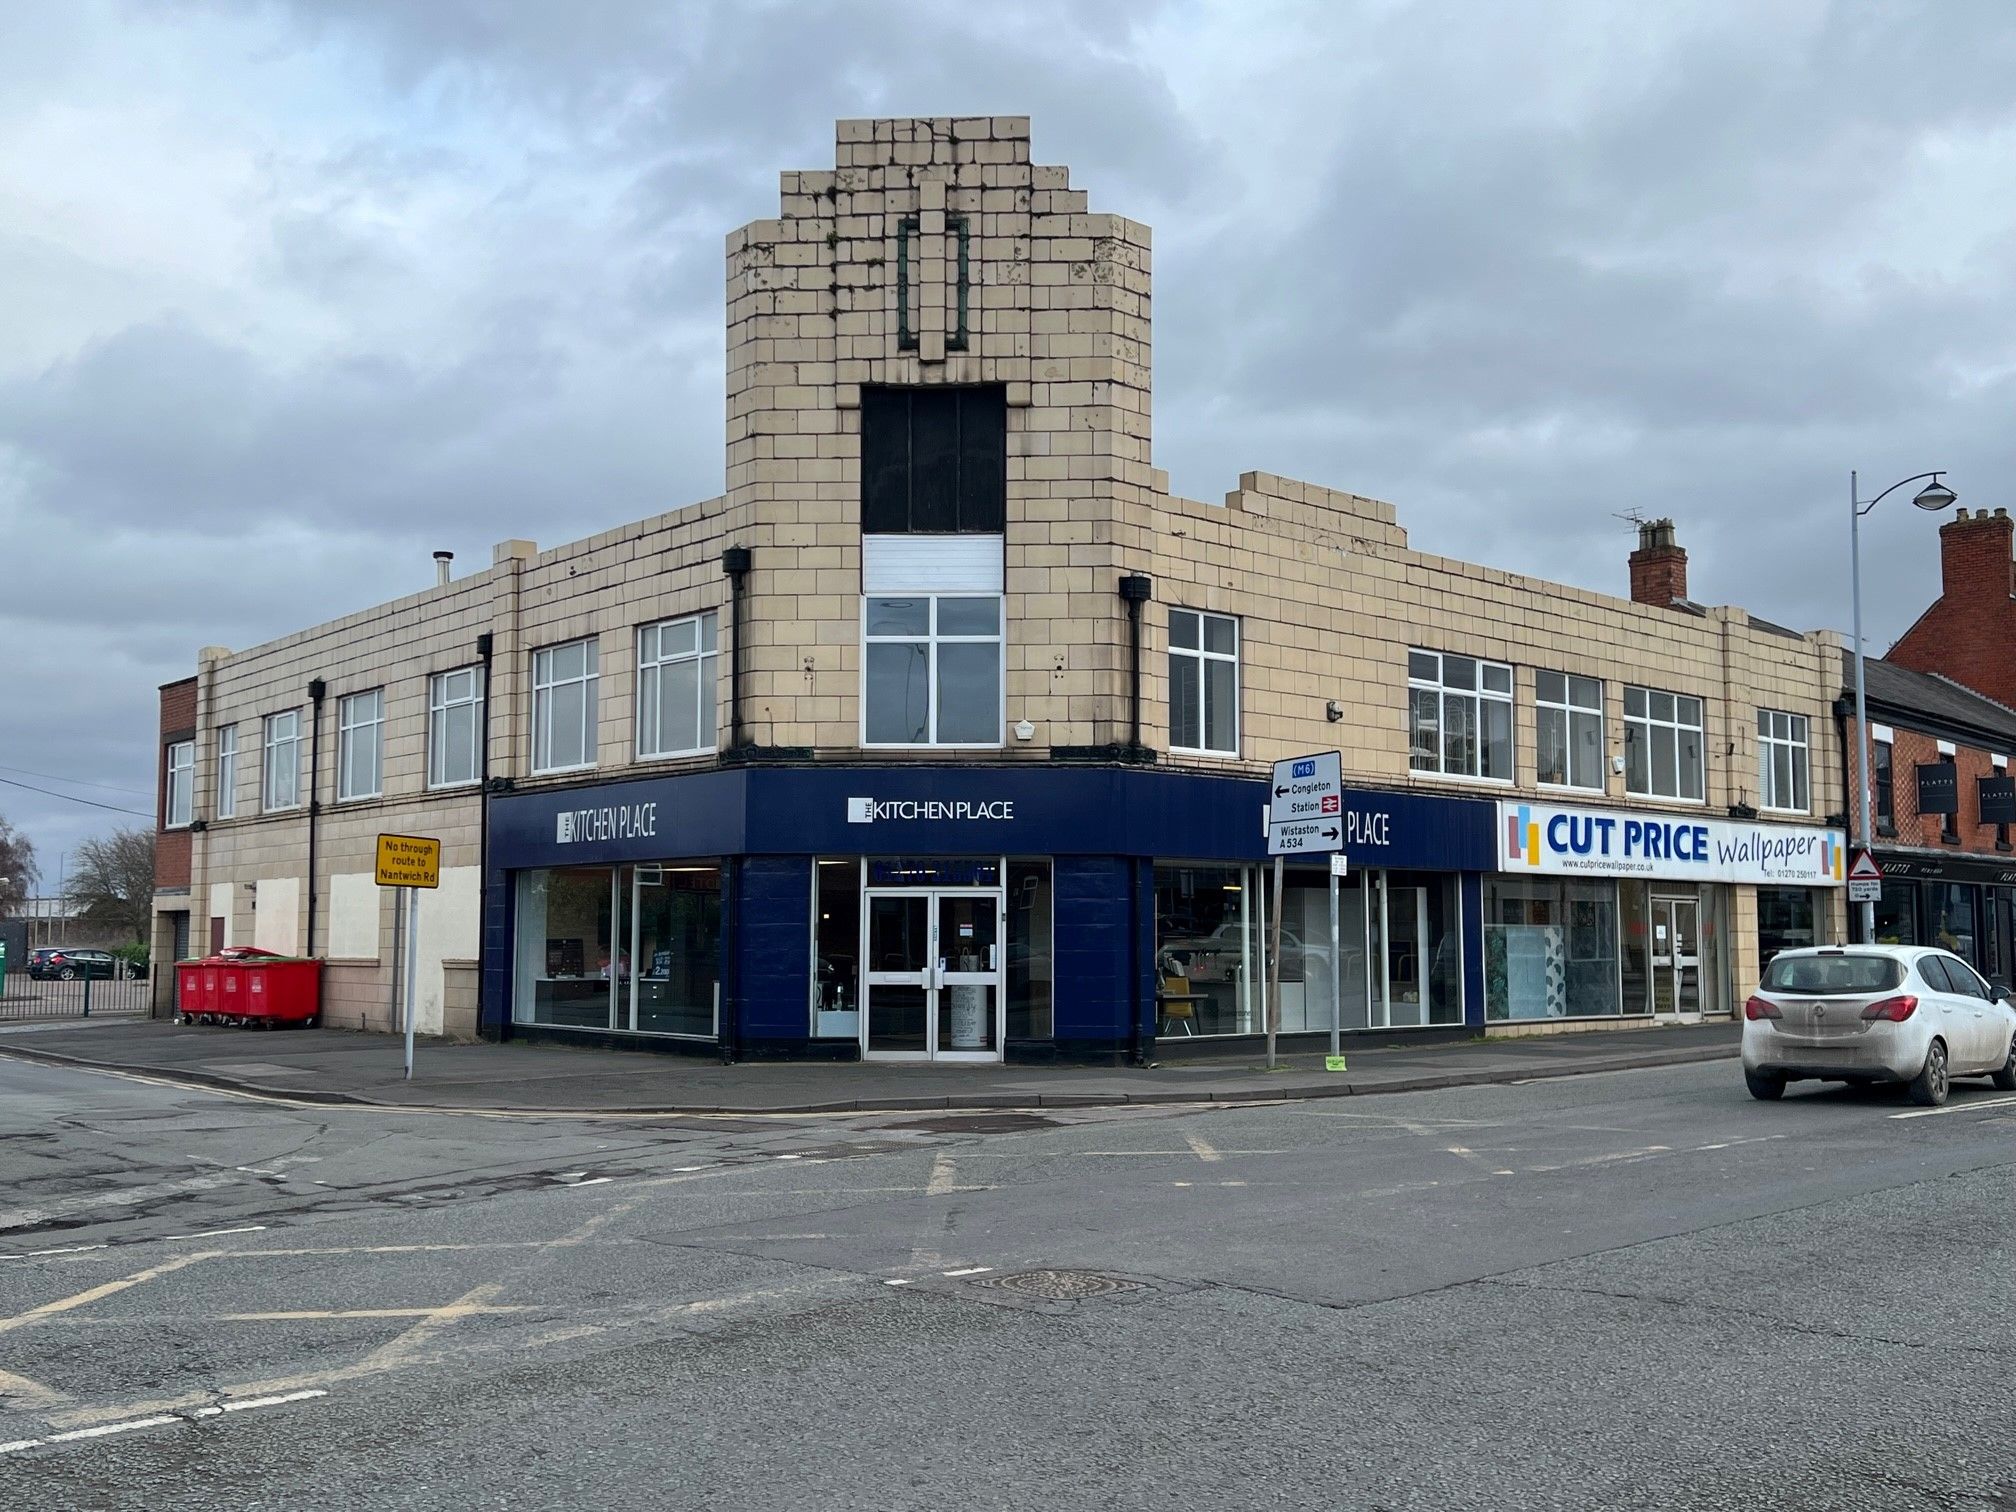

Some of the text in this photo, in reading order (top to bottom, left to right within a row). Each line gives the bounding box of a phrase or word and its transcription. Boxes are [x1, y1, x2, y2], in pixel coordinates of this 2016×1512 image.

[1291, 781, 1331, 795] Congleton
[874, 801, 1014, 820] KITCHEN PLACE
[1291, 802, 1320, 813] Station
[572, 802, 657, 842] KITCHEN PLACE
[1347, 810, 1390, 846] PLACE
[1281, 825, 1320, 836] Wistaston
[385, 841, 433, 856] No through
[1547, 814, 1817, 871] CUT PRICE Wallpaper
[392, 856, 426, 867] route to
[1562, 859, 1654, 873] www.cutpricewallpaper.co.uk
[1882, 863, 1911, 874] PLATTS
[380, 868, 435, 882] Nantwich Rd
[1777, 869, 1796, 878] 01270
[1796, 870, 1817, 879] 250117
